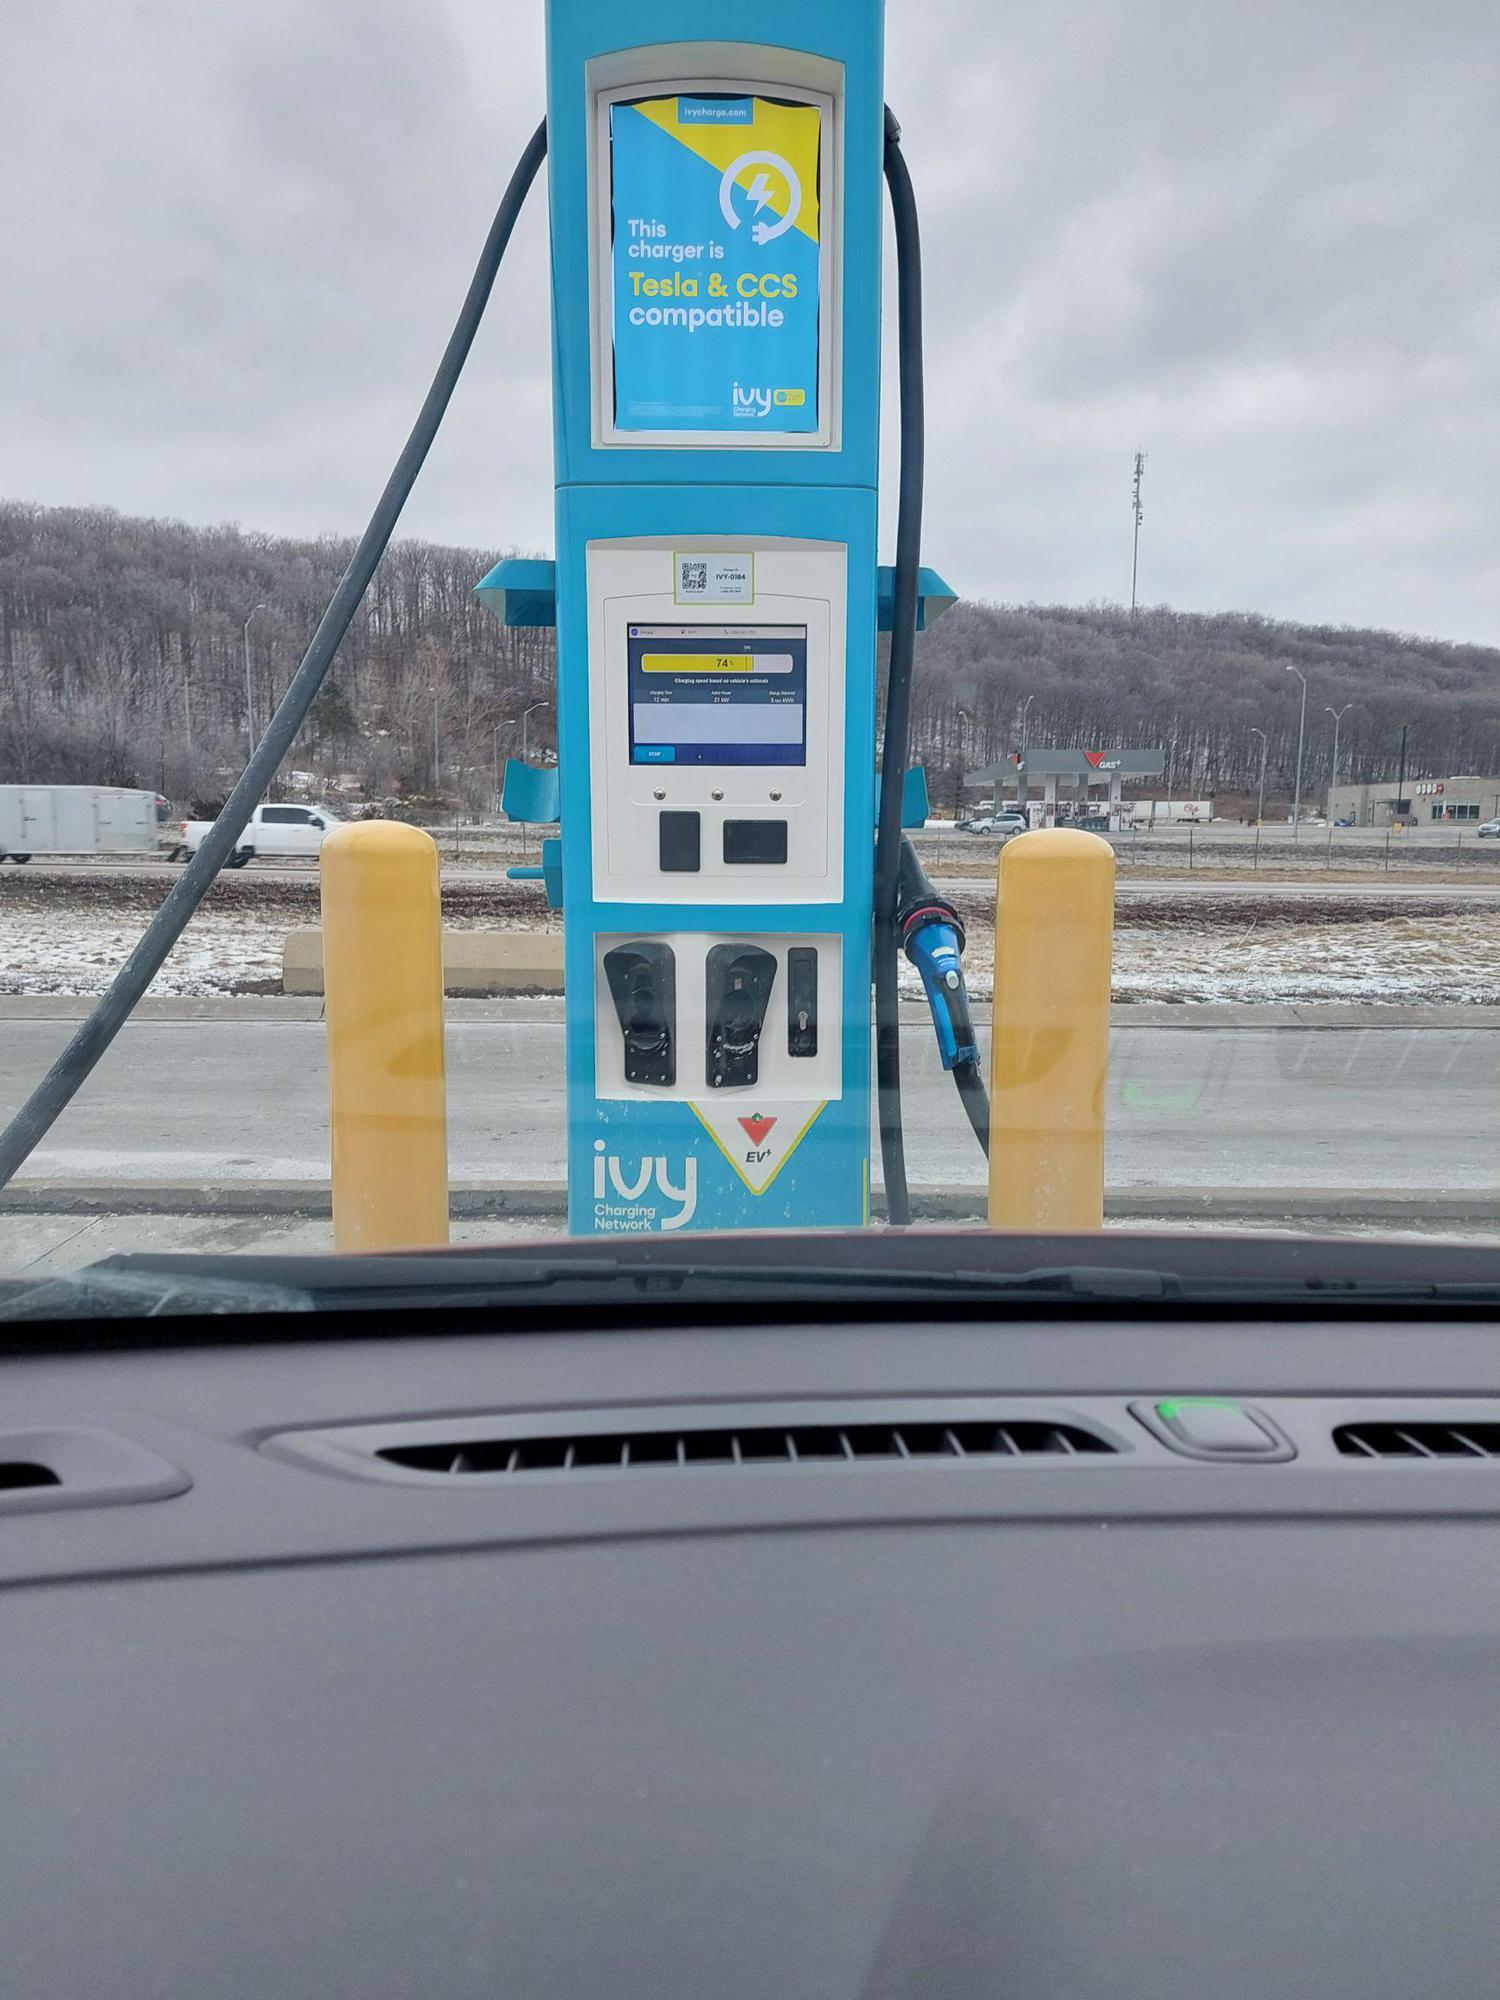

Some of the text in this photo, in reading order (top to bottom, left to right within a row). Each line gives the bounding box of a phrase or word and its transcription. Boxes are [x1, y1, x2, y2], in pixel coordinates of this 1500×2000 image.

[684, 106, 747, 118] ivycharge.com
[628, 219, 667, 237] This
[628, 240, 724, 263] charger is
[628, 271, 798, 298] Tesla & CCS
[629, 301, 785, 333] compatible
[733, 382, 771, 417] ivy
[745, 1151, 766, 1163] EV
[594, 1139, 698, 1231] ivy
[594, 1204, 656, 1218] Charging
[594, 1218, 652, 1230] Network
